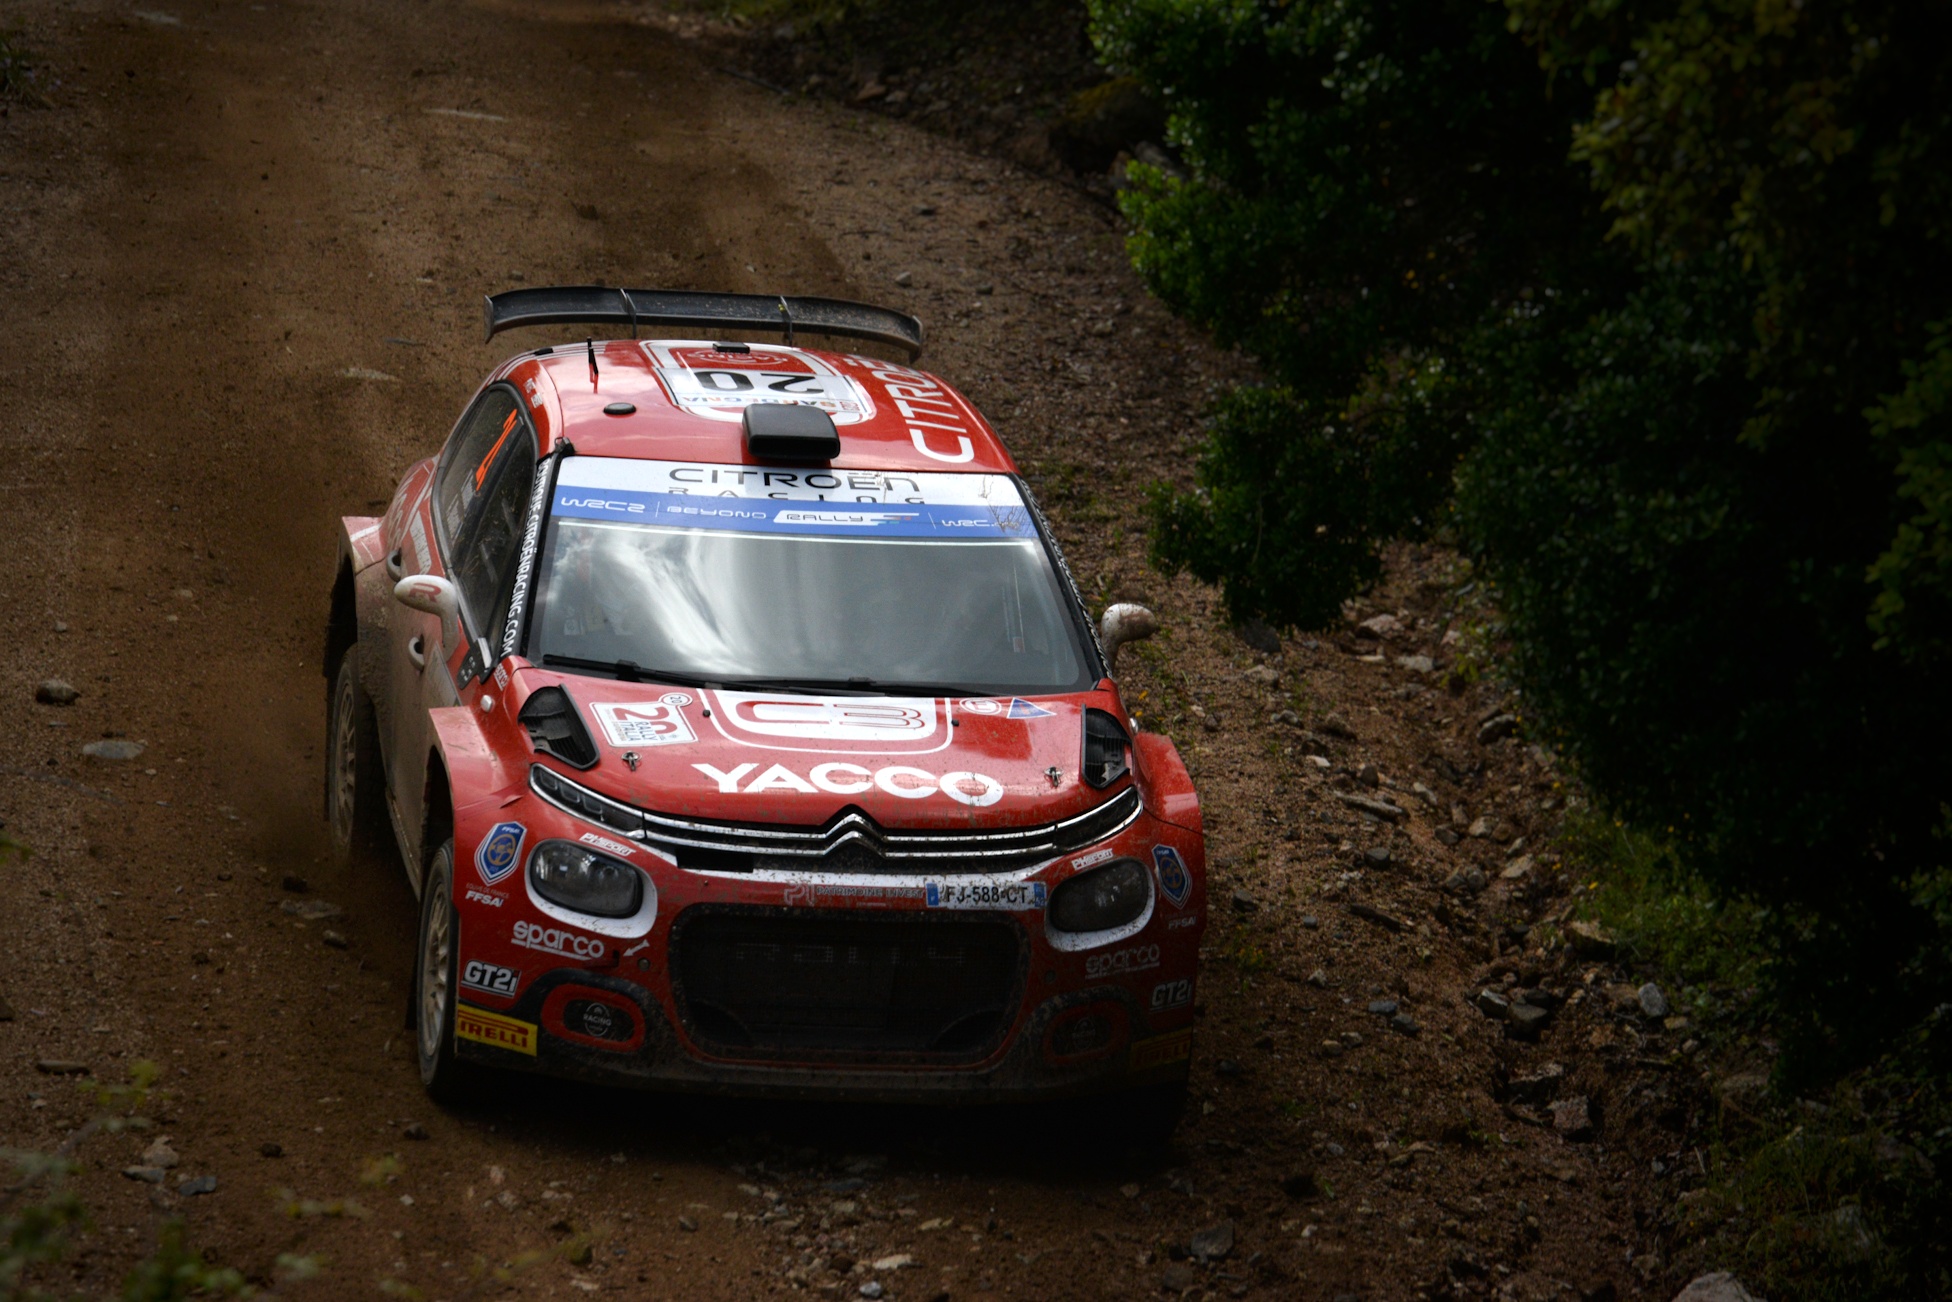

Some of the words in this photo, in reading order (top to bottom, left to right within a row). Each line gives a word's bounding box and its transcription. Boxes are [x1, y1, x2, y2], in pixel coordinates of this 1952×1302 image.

[695, 370, 824, 394] 20
[843, 354, 975, 463] CITROË
[669, 467, 920, 492] CITROËN
[561, 497, 646, 513] WRC2
[667, 505, 767, 519] BEYOND
[786, 513, 864, 522] RALLY
[735, 700, 925, 729] C3
[618, 721, 642, 742] ITALIA
[634, 721, 658, 741] RALLY
[691, 762, 1004, 807] YACCO
[816, 885, 883, 898] PATRIMOINE
[512, 920, 605, 959] sparco
[463, 960, 519, 992] GT2i
